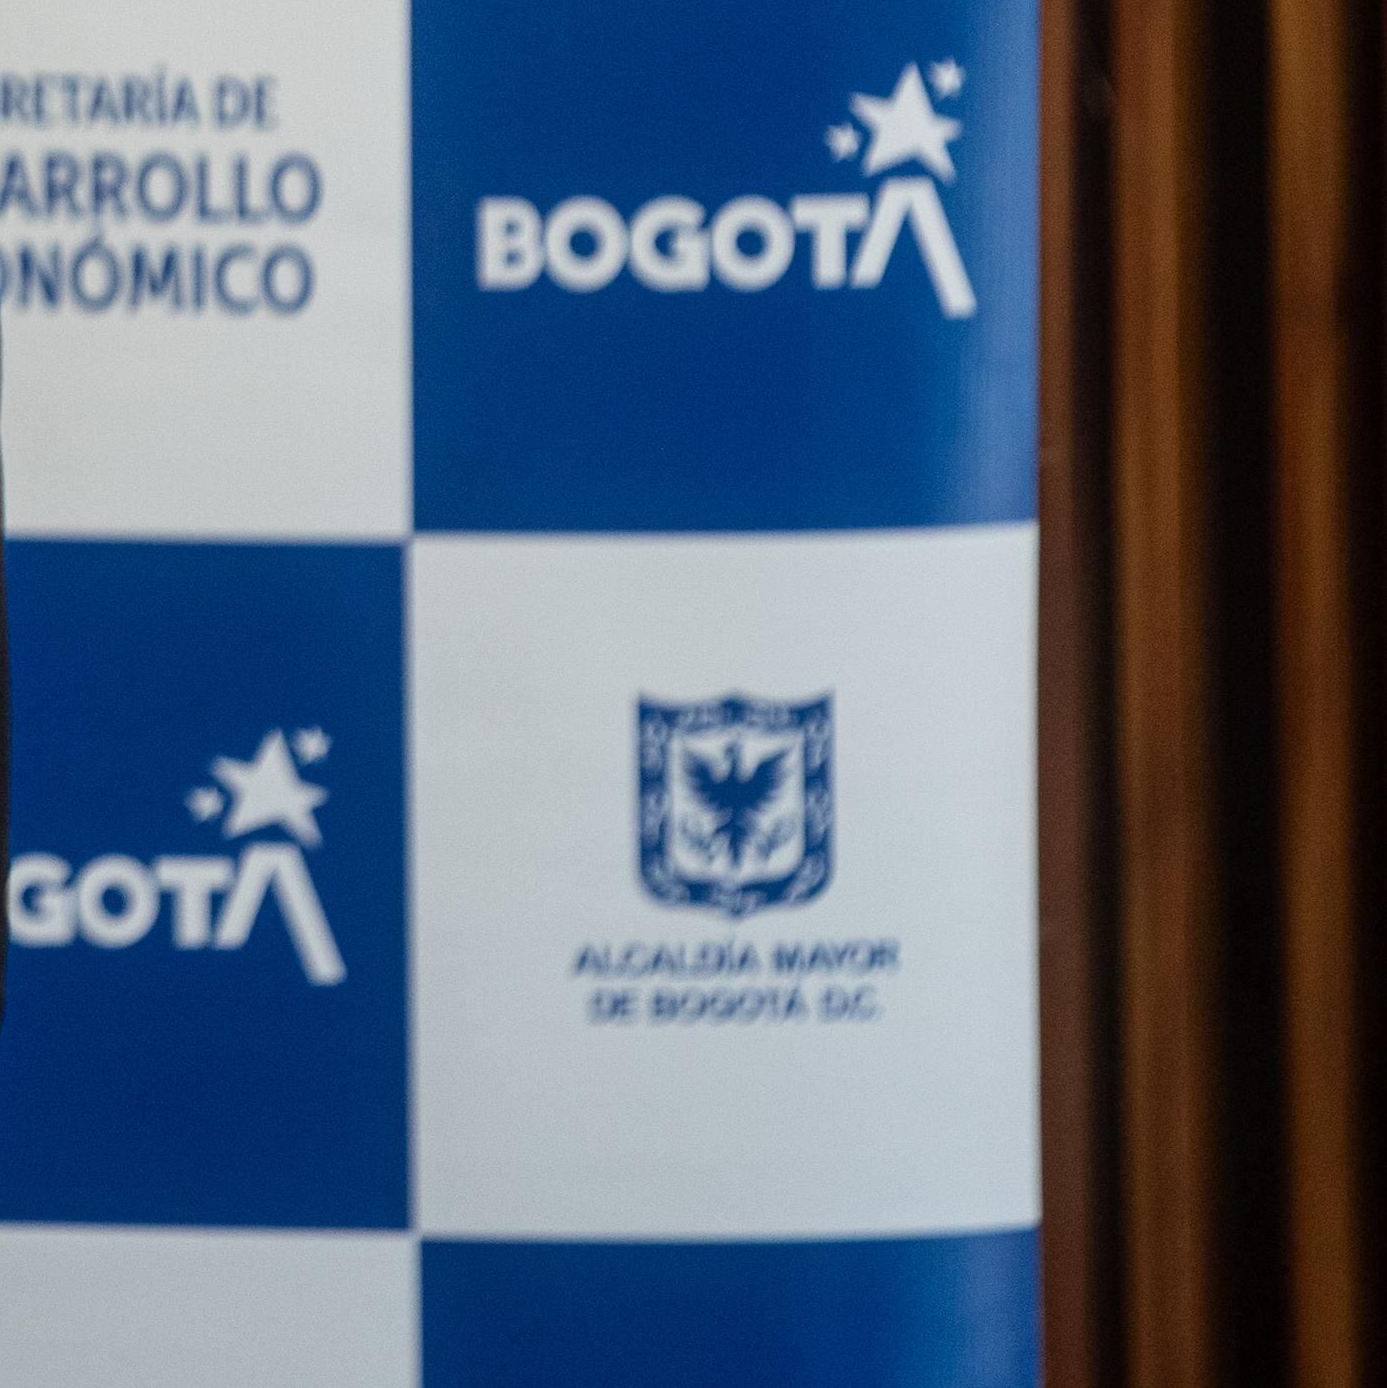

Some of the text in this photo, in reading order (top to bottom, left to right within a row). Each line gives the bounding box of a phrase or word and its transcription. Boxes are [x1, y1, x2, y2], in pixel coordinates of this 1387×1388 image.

[210, 75, 277, 131] DE
[771, 937, 900, 976] MAYOR
[588, 988, 639, 1025] DE
